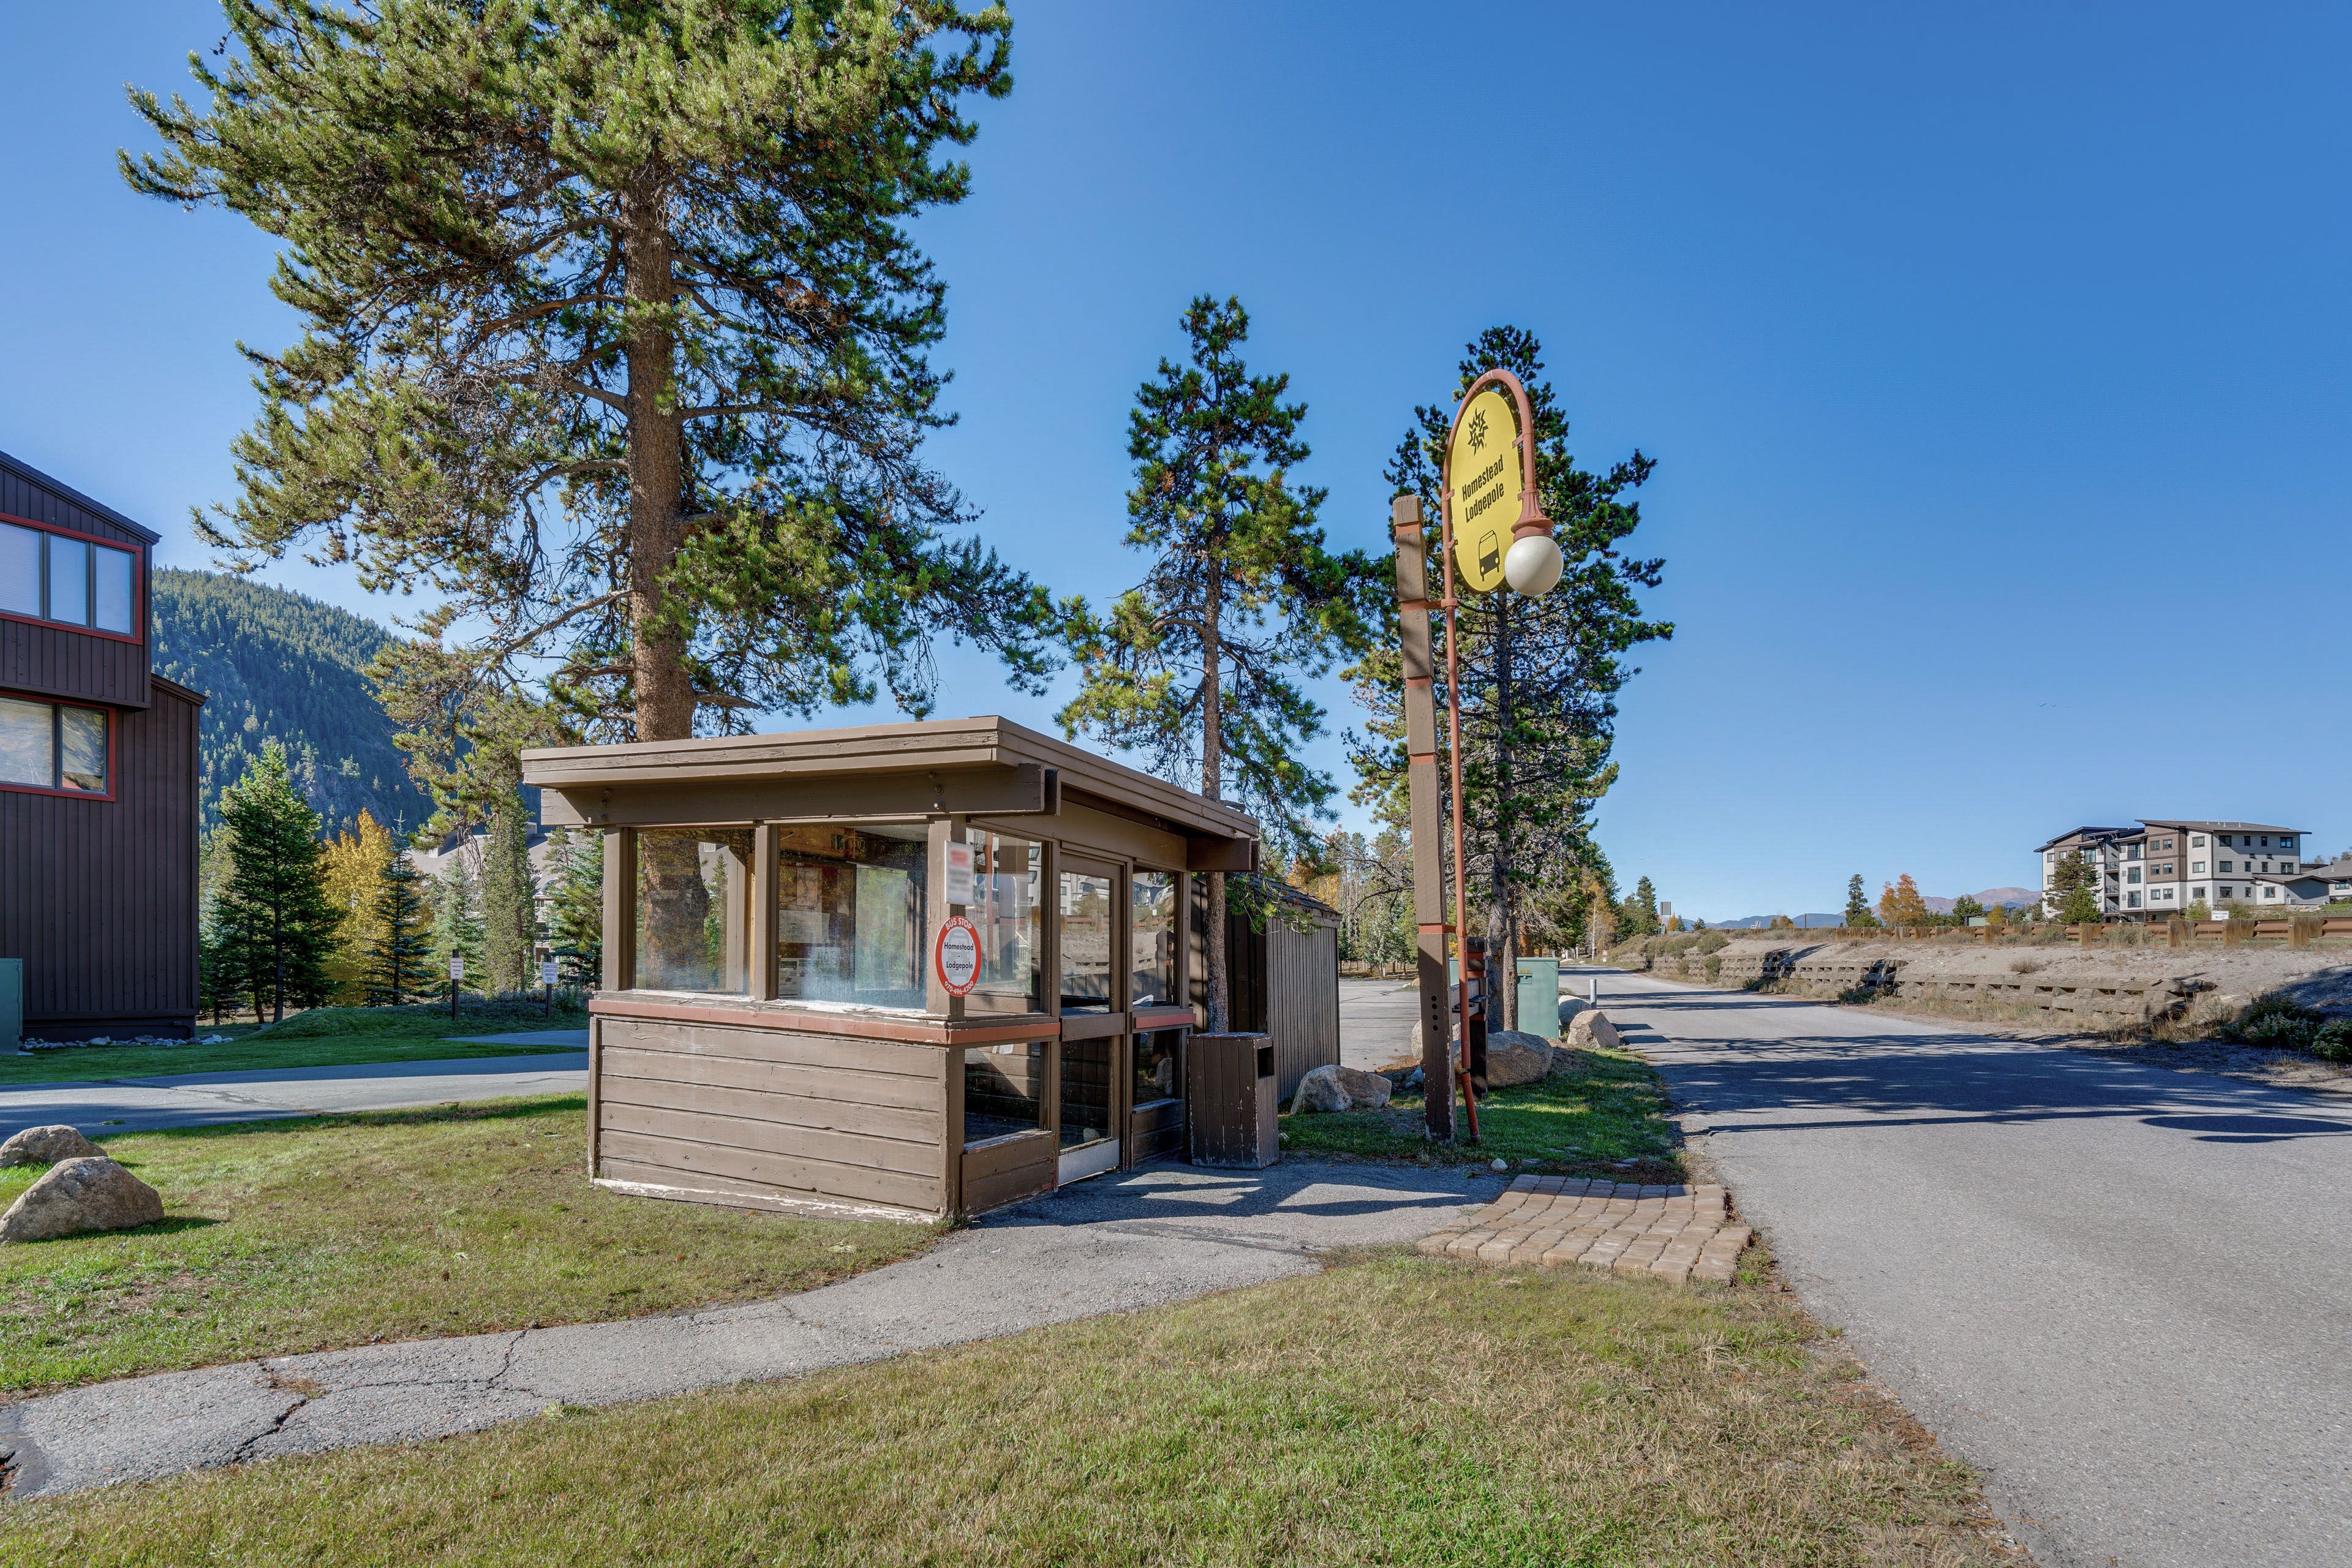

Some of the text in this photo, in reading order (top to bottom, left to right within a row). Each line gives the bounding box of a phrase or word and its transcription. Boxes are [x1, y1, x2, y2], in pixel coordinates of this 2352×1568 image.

[1461, 454, 1504, 502] Homestead
[1465, 482, 1504, 523] Lodgepole
[945, 917, 972, 930] BUS STOP
[944, 942, 974, 951] Homestead
[946, 960, 973, 970] Lodgepole
[944, 981, 974, 995] 970-496-4200
